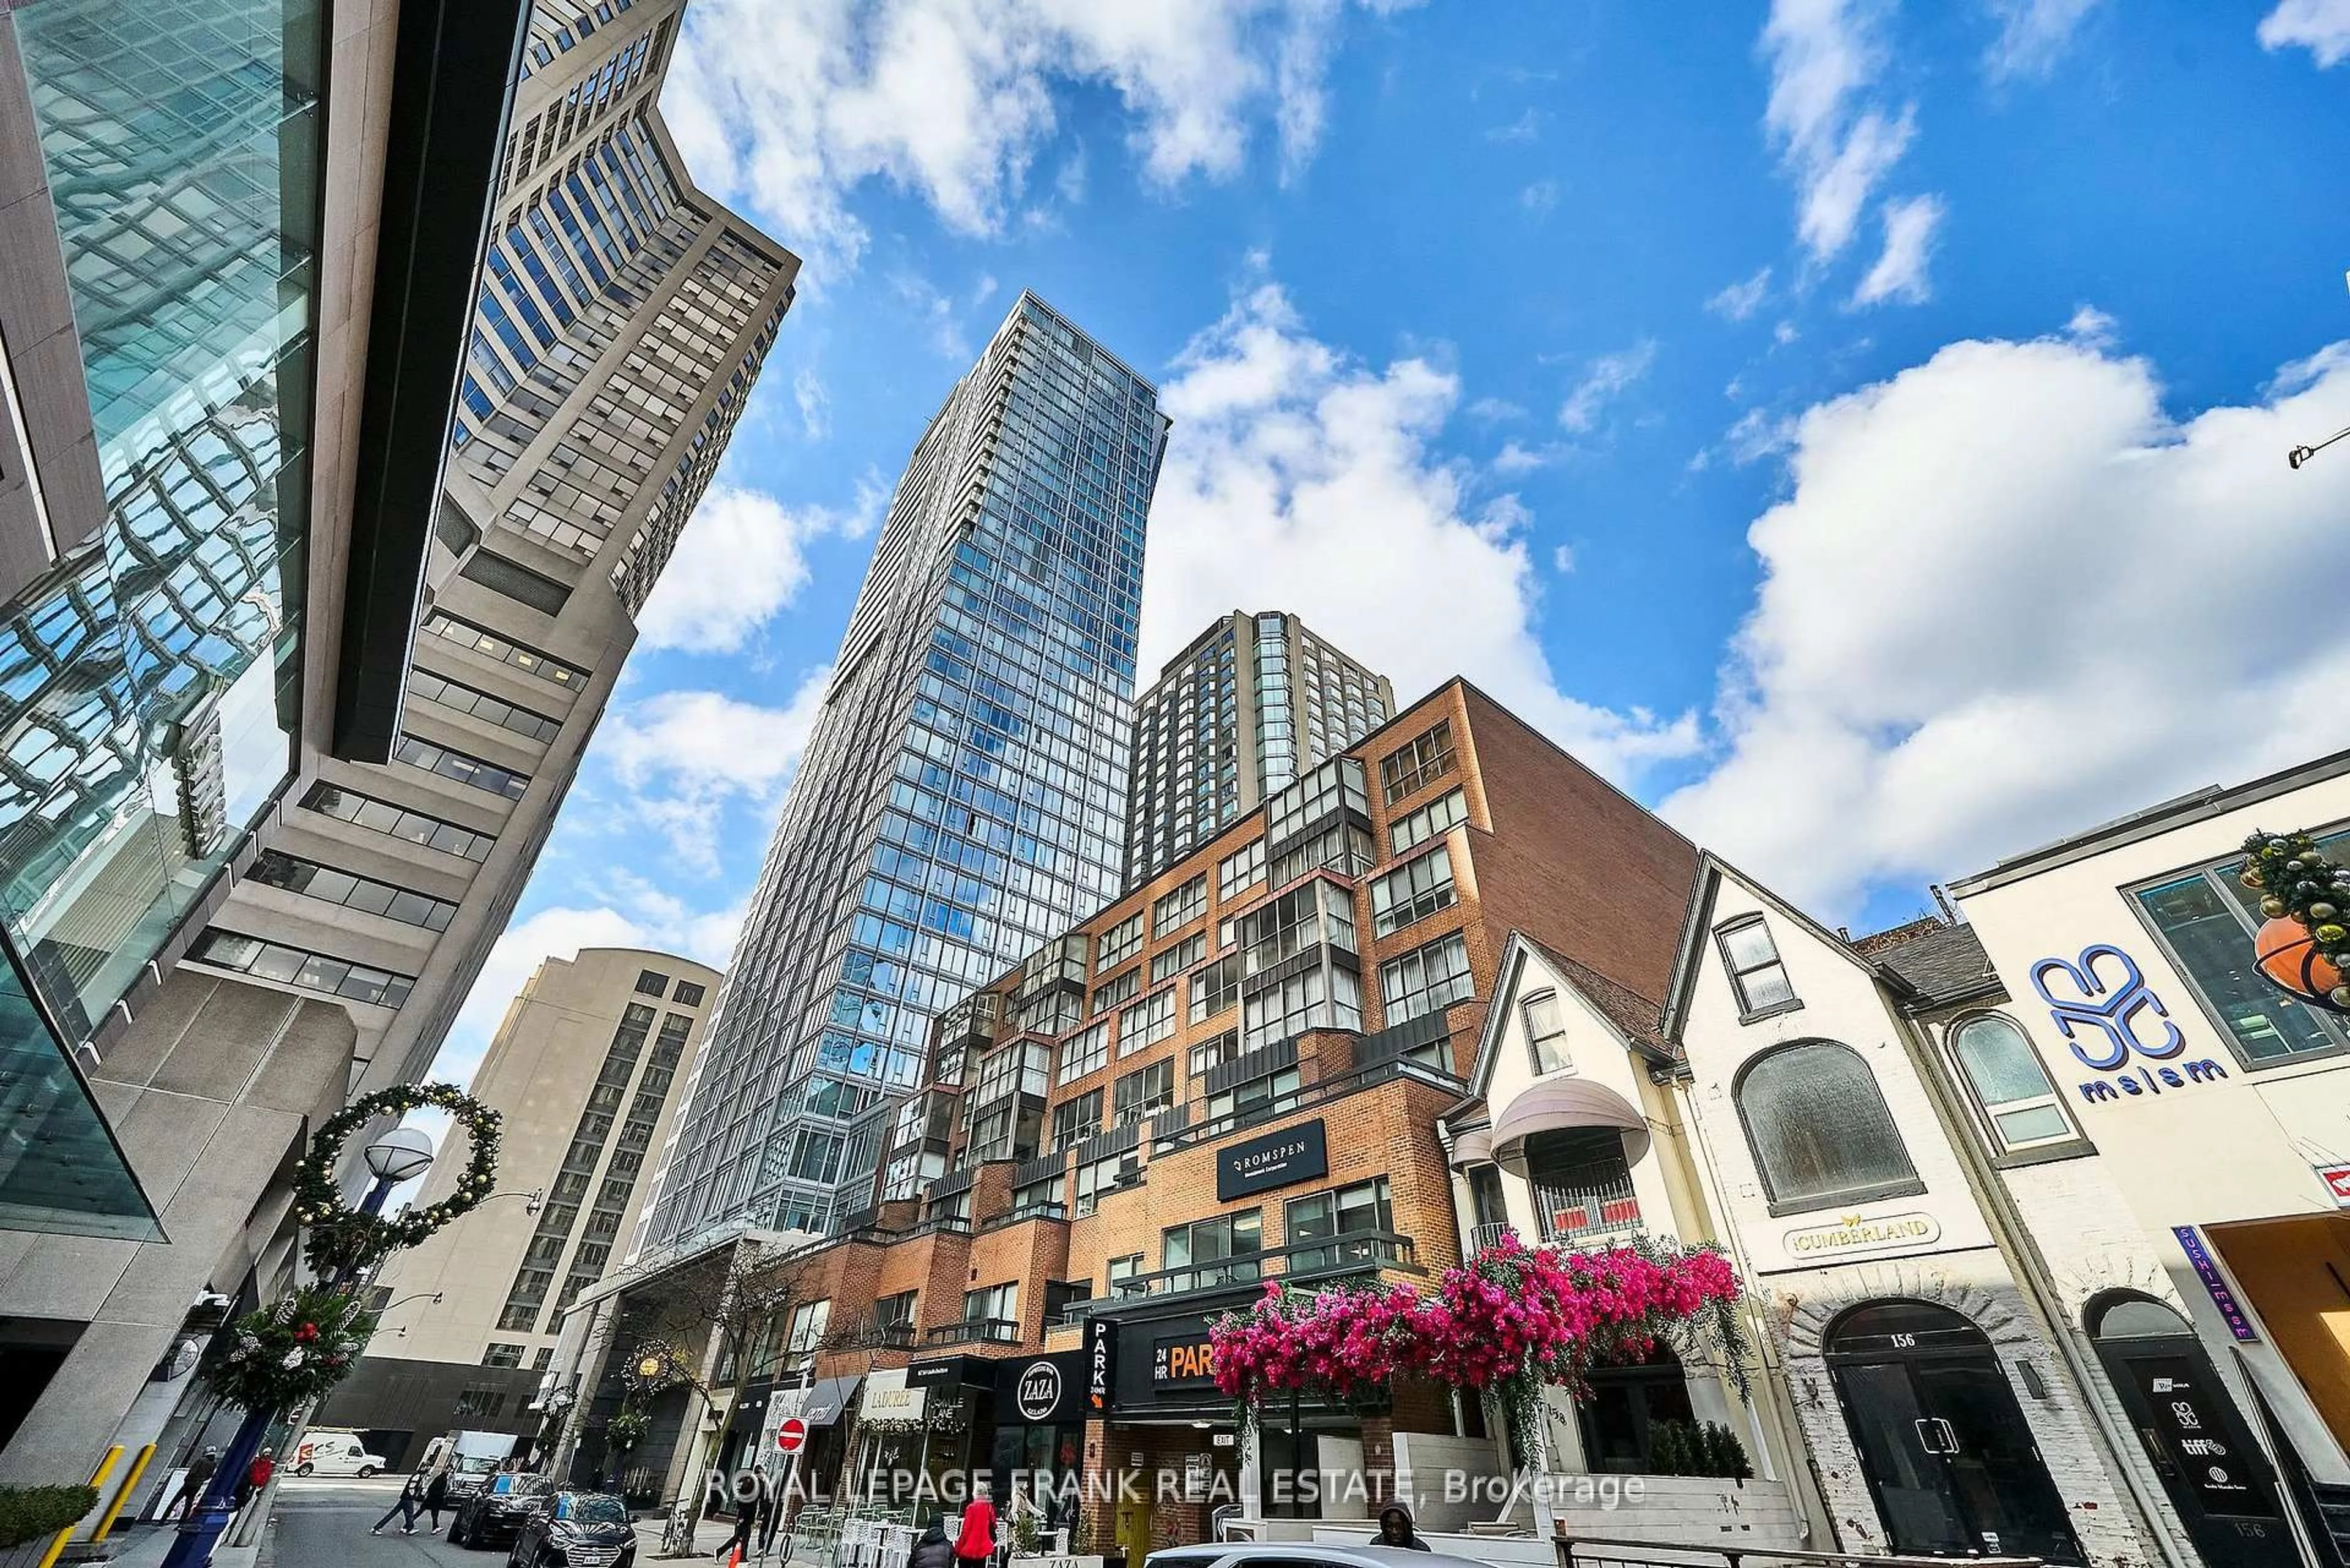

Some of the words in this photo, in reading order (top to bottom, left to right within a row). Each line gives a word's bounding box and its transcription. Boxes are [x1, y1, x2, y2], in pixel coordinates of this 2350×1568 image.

[1244, 1141, 1305, 1168] ROMSPEN
[2180, 1228, 2213, 1280] SUSHI
[1891, 1333, 1915, 1347] 156
[1094, 1323, 1106, 1386] PARK
[1156, 1348, 1166, 1363] 24
[1171, 1343, 1215, 1378] PAR
[1155, 1365, 1168, 1379] HR
[1023, 1378, 1053, 1401] ZAZA
[1547, 1403, 1567, 1425] 158
